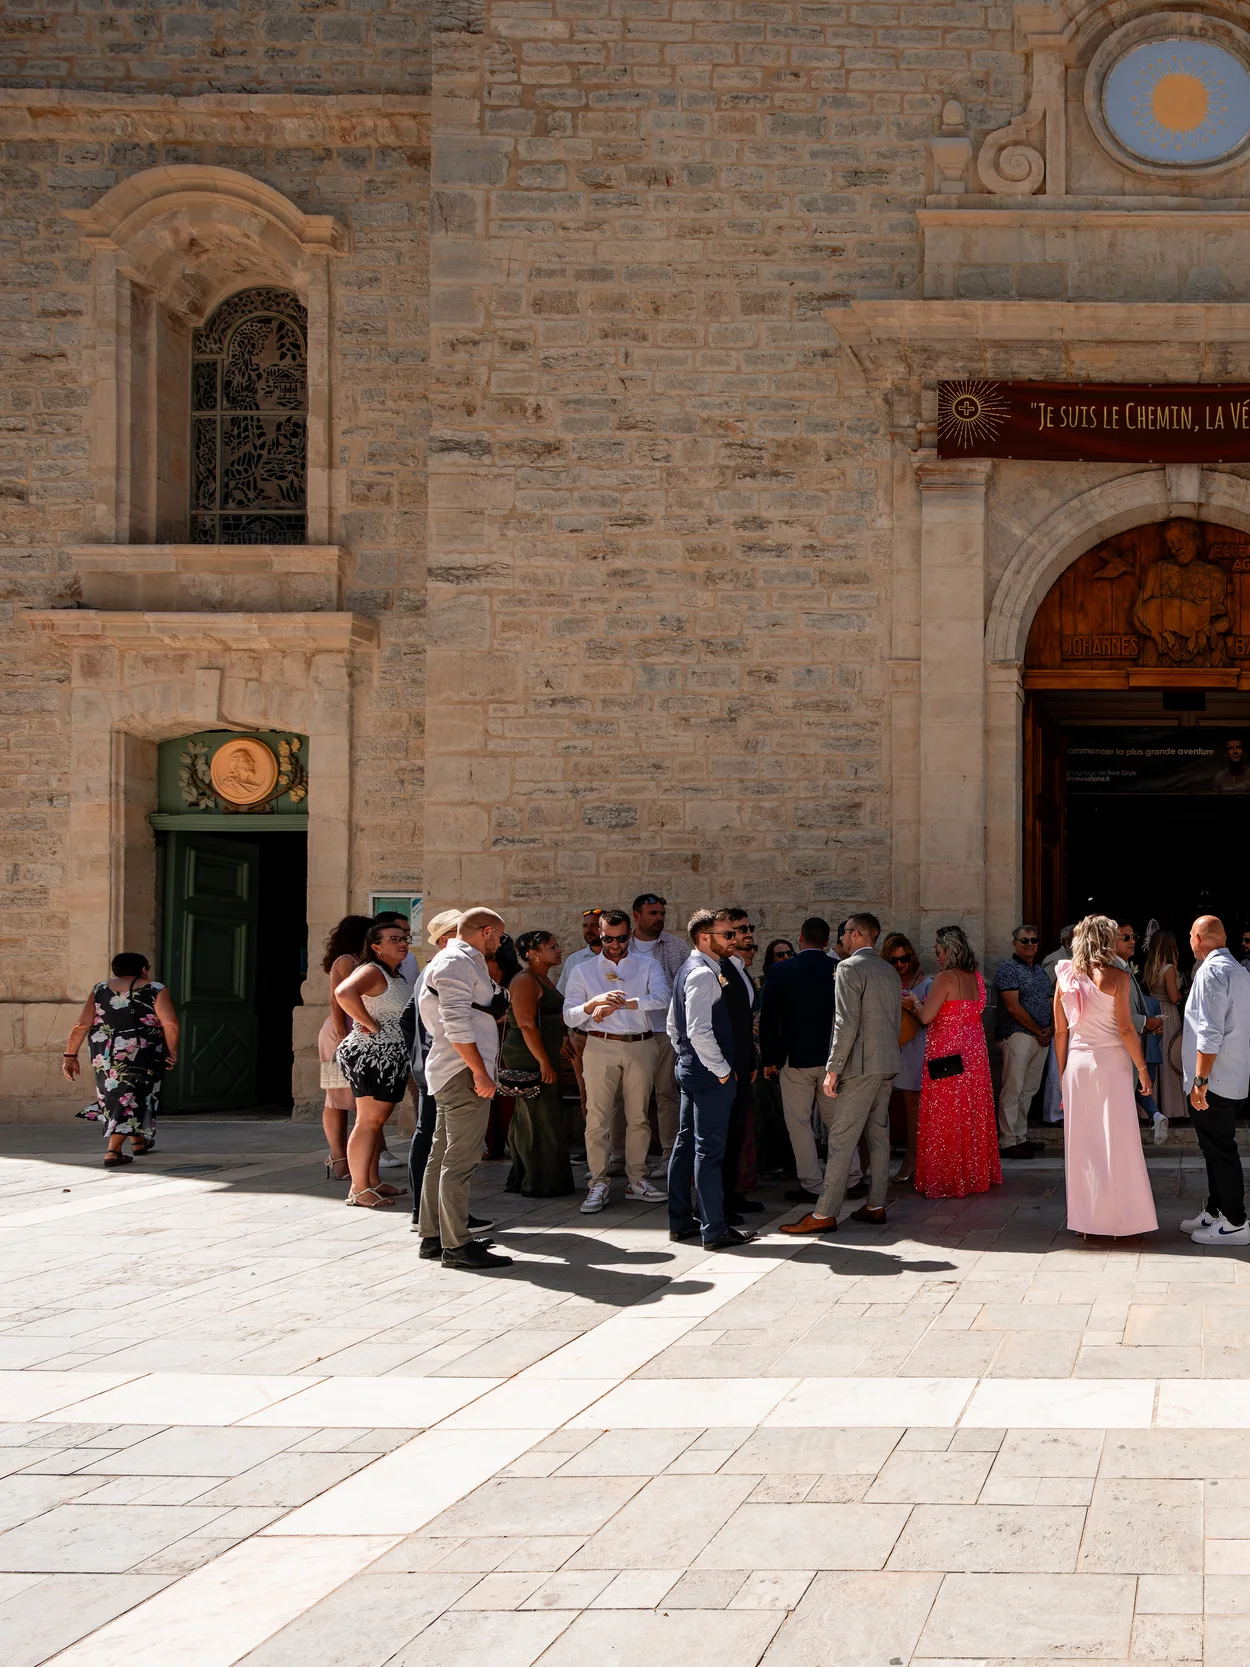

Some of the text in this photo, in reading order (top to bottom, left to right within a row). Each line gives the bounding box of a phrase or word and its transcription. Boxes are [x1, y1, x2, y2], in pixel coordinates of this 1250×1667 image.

[1214, 544, 1246, 557] ECCE
[1063, 637, 1139, 656] JOHANNES
[1115, 747, 1125, 755] la
[1125, 747, 1144, 757] plus
[1145, 747, 1176, 757] grande
[1177, 747, 1215, 756] aventure
